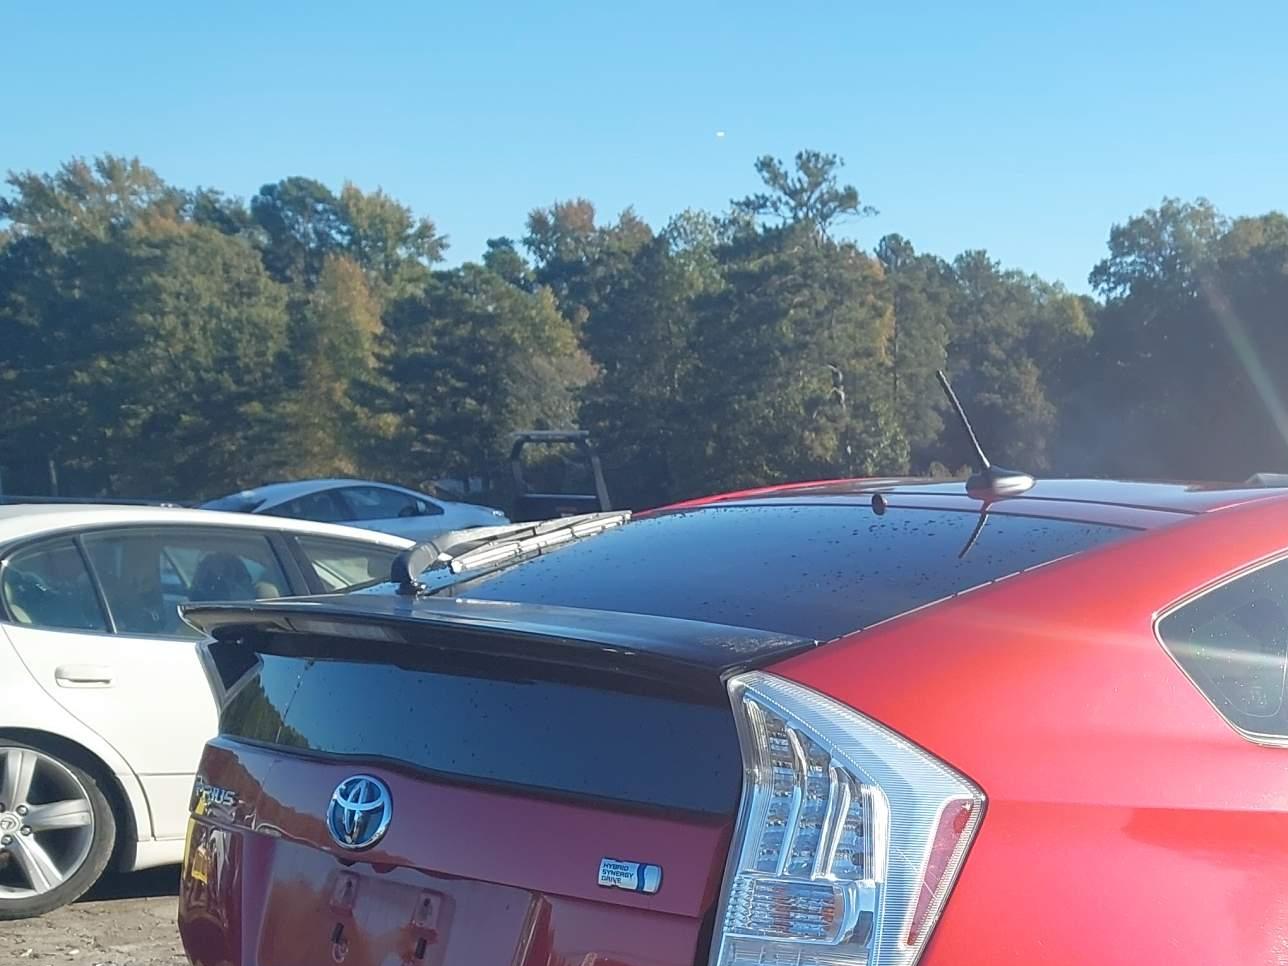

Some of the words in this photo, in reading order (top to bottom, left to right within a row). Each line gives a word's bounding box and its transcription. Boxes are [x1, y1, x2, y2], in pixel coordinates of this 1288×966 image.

[196, 783, 236, 806] PRIUS
[603, 863, 629, 871] HYBRID
[602, 869, 634, 878] SYNERGY
[601, 875, 622, 884] DRIVE
